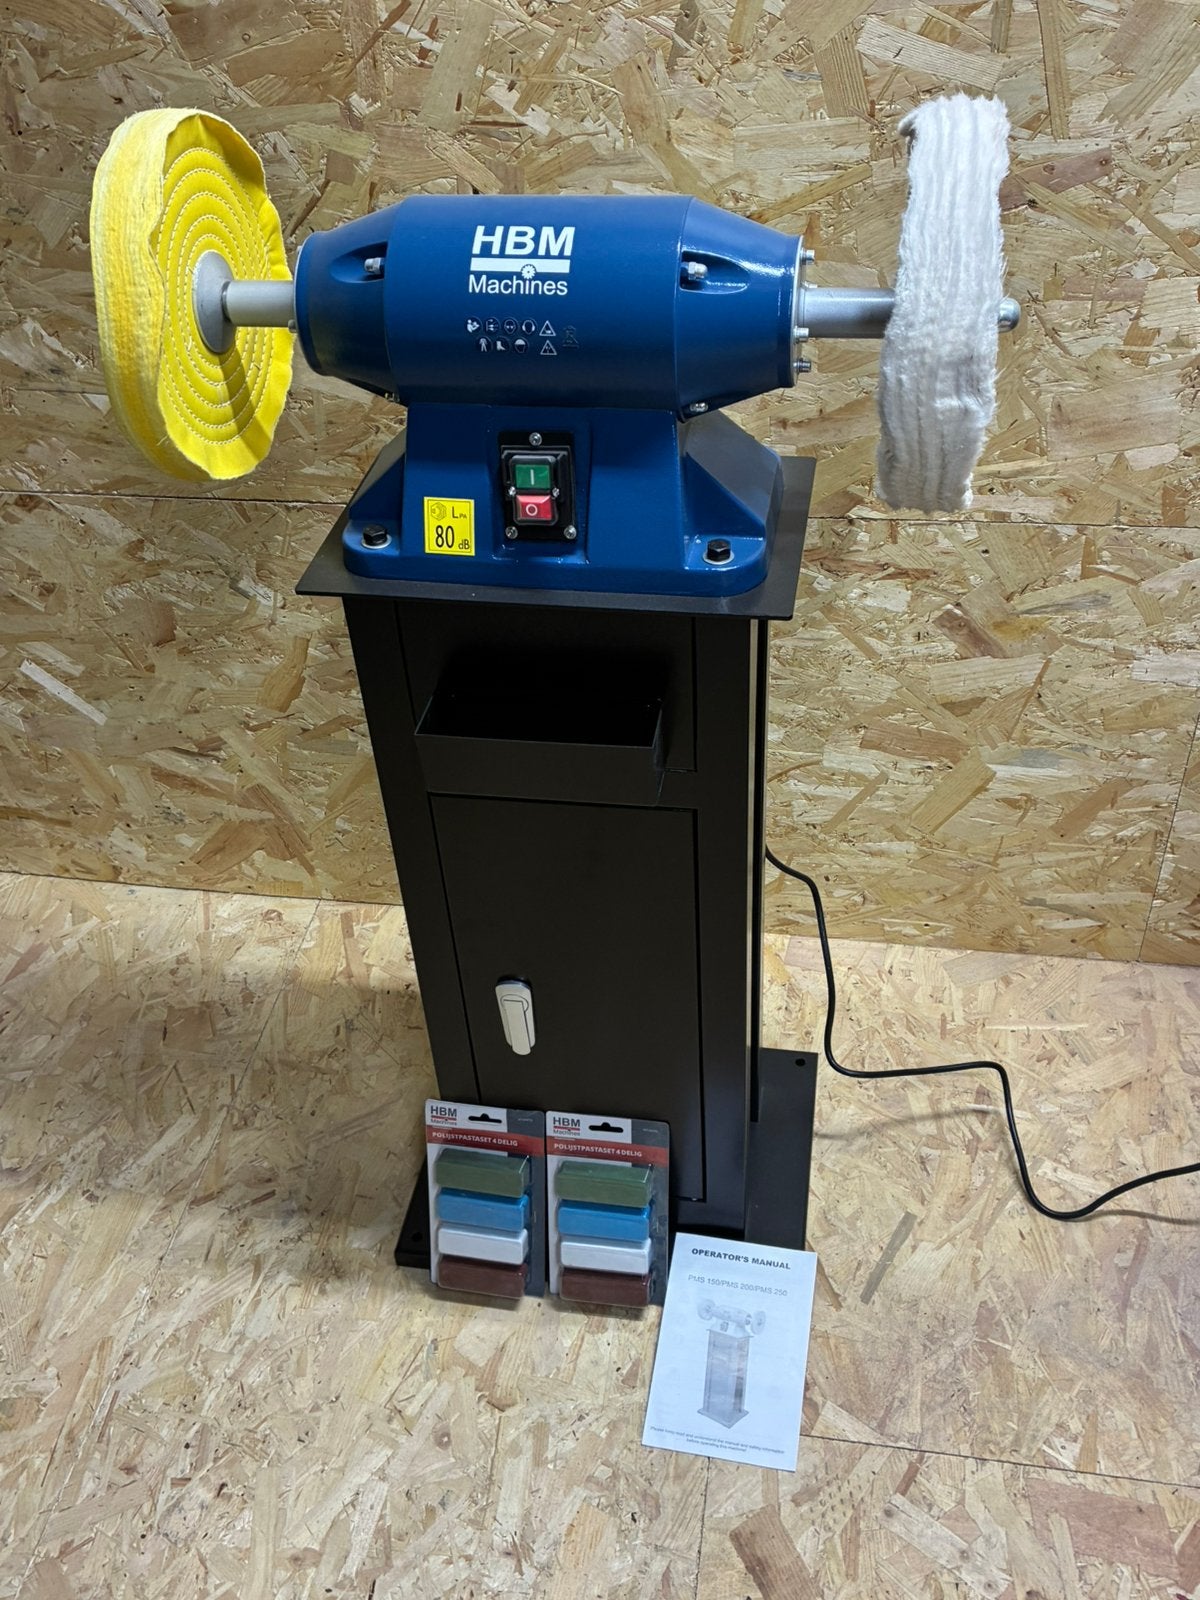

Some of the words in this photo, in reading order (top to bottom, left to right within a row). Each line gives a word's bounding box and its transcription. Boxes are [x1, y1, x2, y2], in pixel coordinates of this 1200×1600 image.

[472, 225, 576, 256] HBM
[468, 274, 568, 296] Machines
[435, 525, 455, 548] 80
[458, 538, 470, 550] dB
[430, 1105, 457, 1118] HBM
[553, 1116, 581, 1128] HBM
[497, 1139, 518, 1147] DELIG
[553, 1129, 581, 1137] Machines
[691, 1248, 749, 1263] OPERATOR'S
[751, 1257, 791, 1270] MANUAL
[688, 1274, 706, 1284] PMS
[773, 1288, 788, 1297] 250
